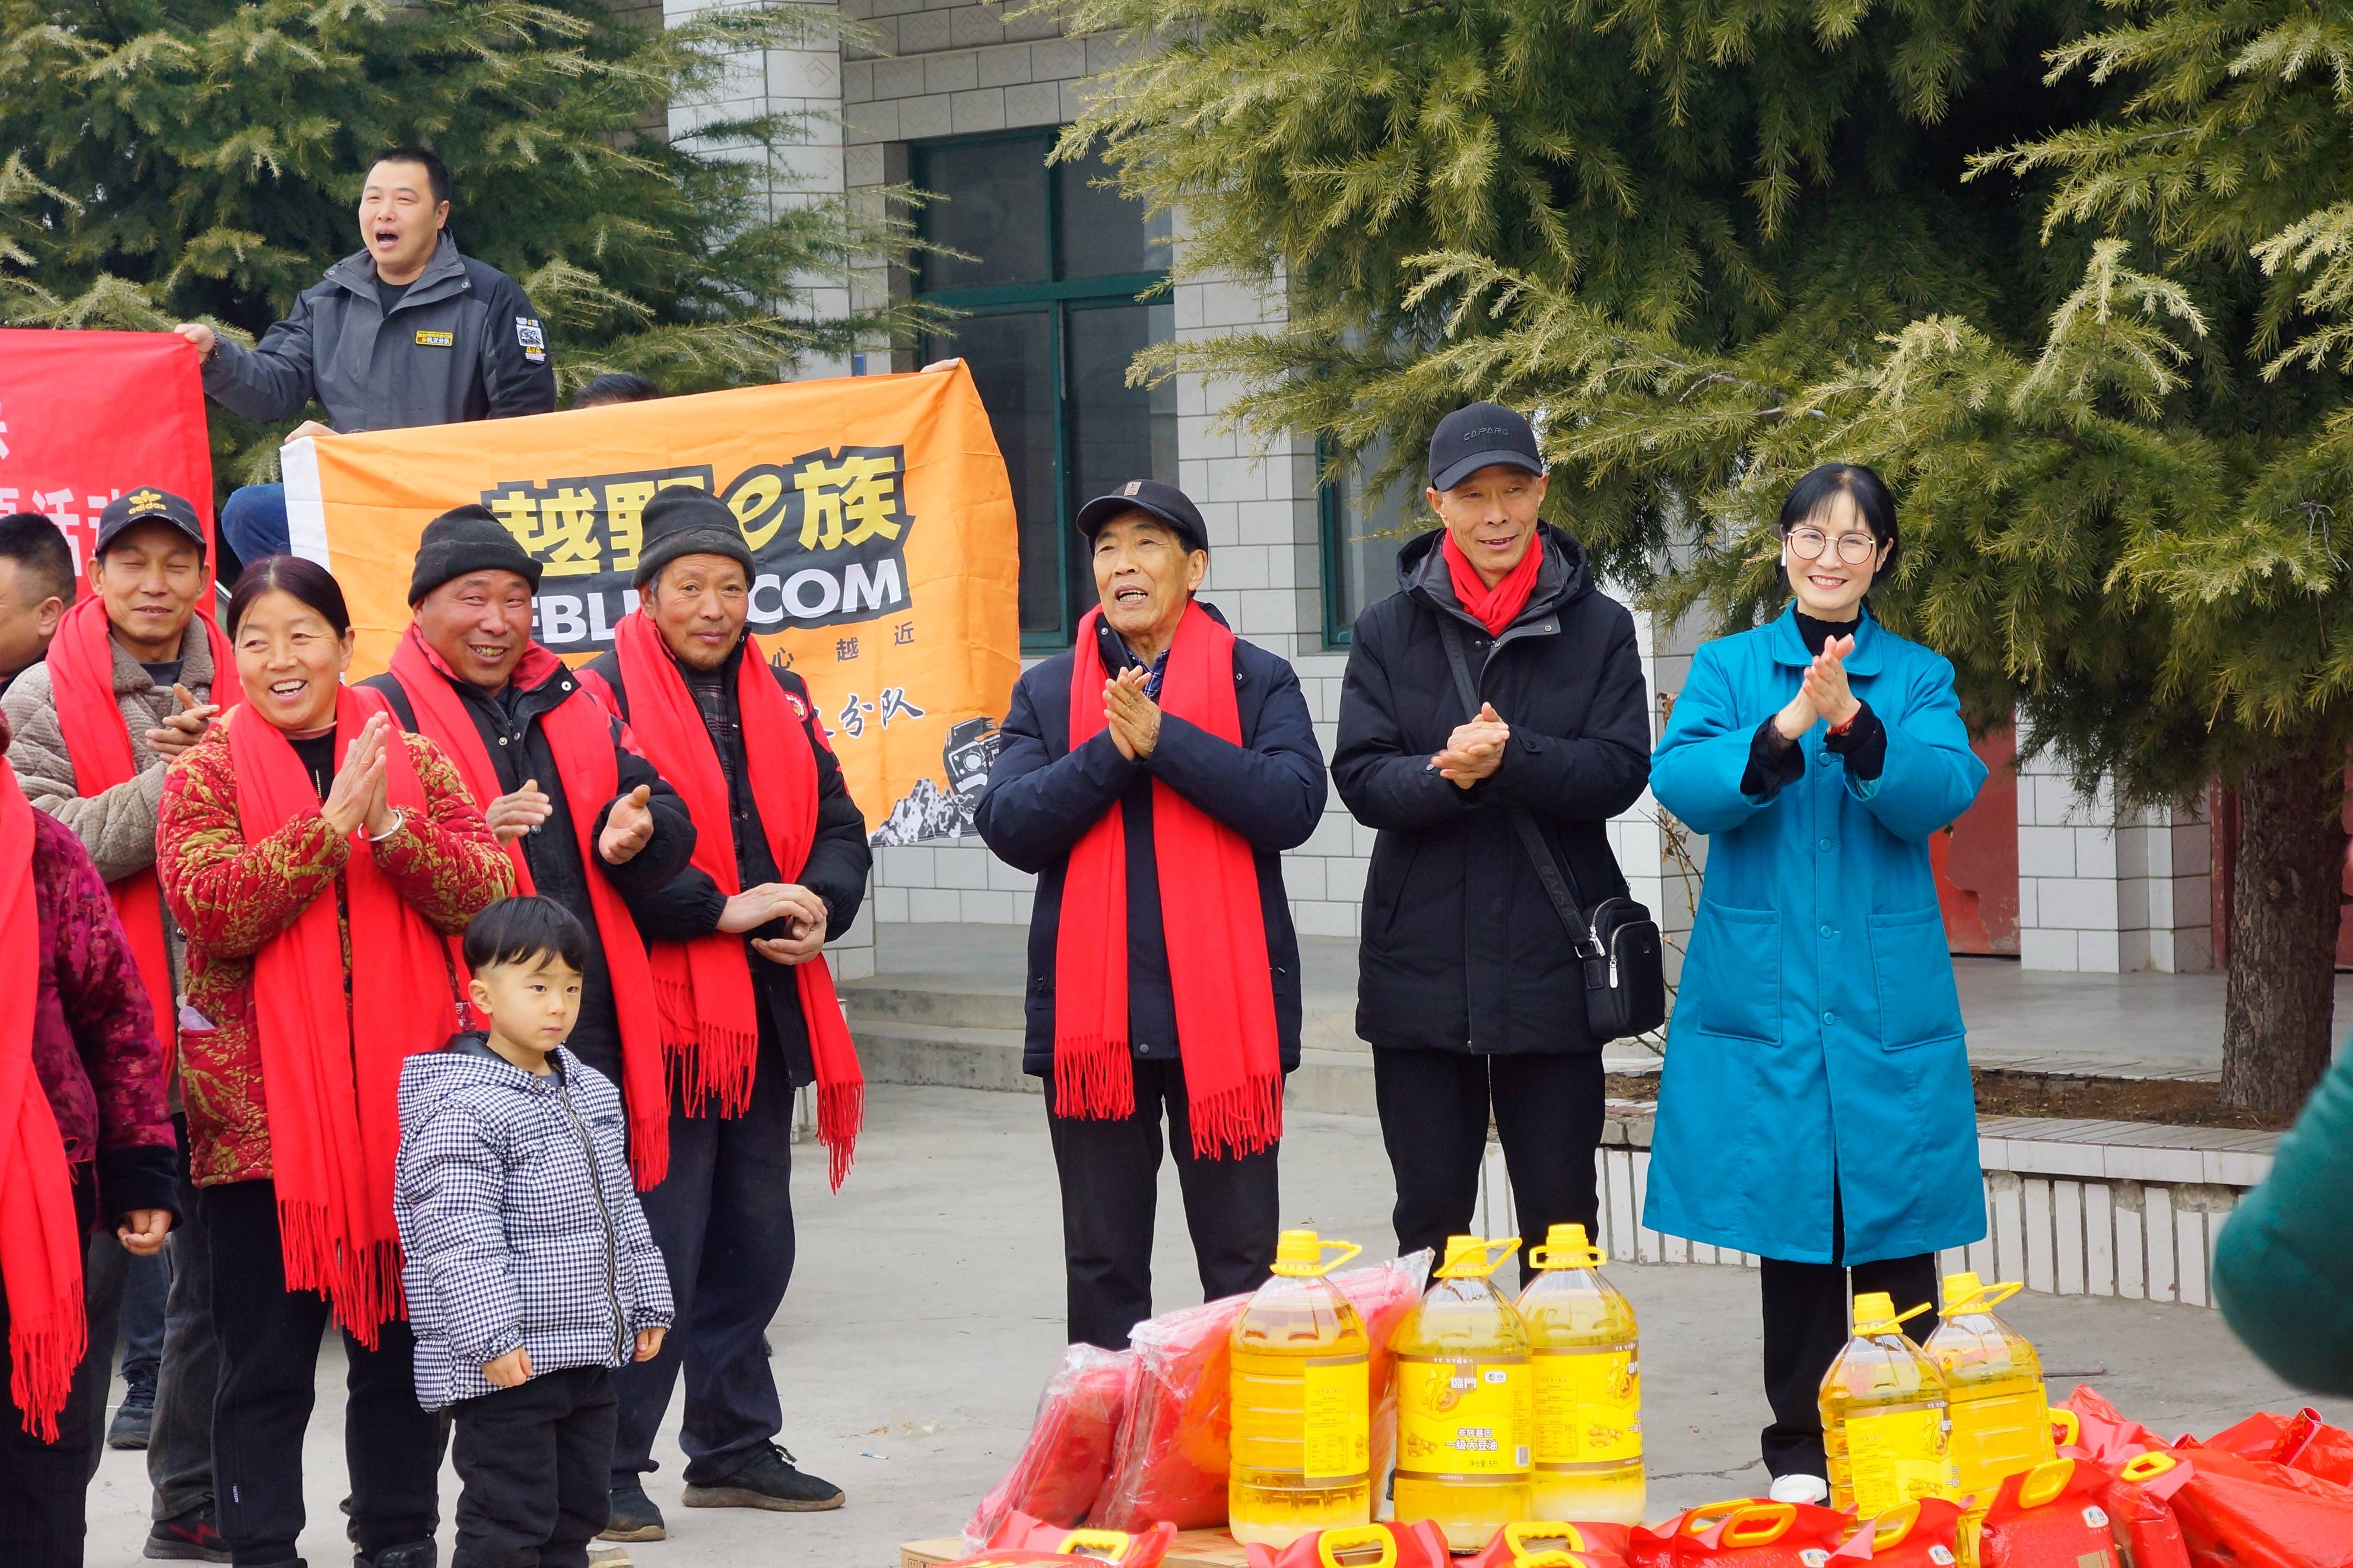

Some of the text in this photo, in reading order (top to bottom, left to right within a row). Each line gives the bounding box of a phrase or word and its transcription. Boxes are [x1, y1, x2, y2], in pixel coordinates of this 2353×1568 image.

[128, 502, 167, 514] adidas
[813, 689, 925, 738] 分队
[1457, 1428, 1493, 1438] 非转基因
[1444, 1439, 1498, 1451] 一级大豆油
